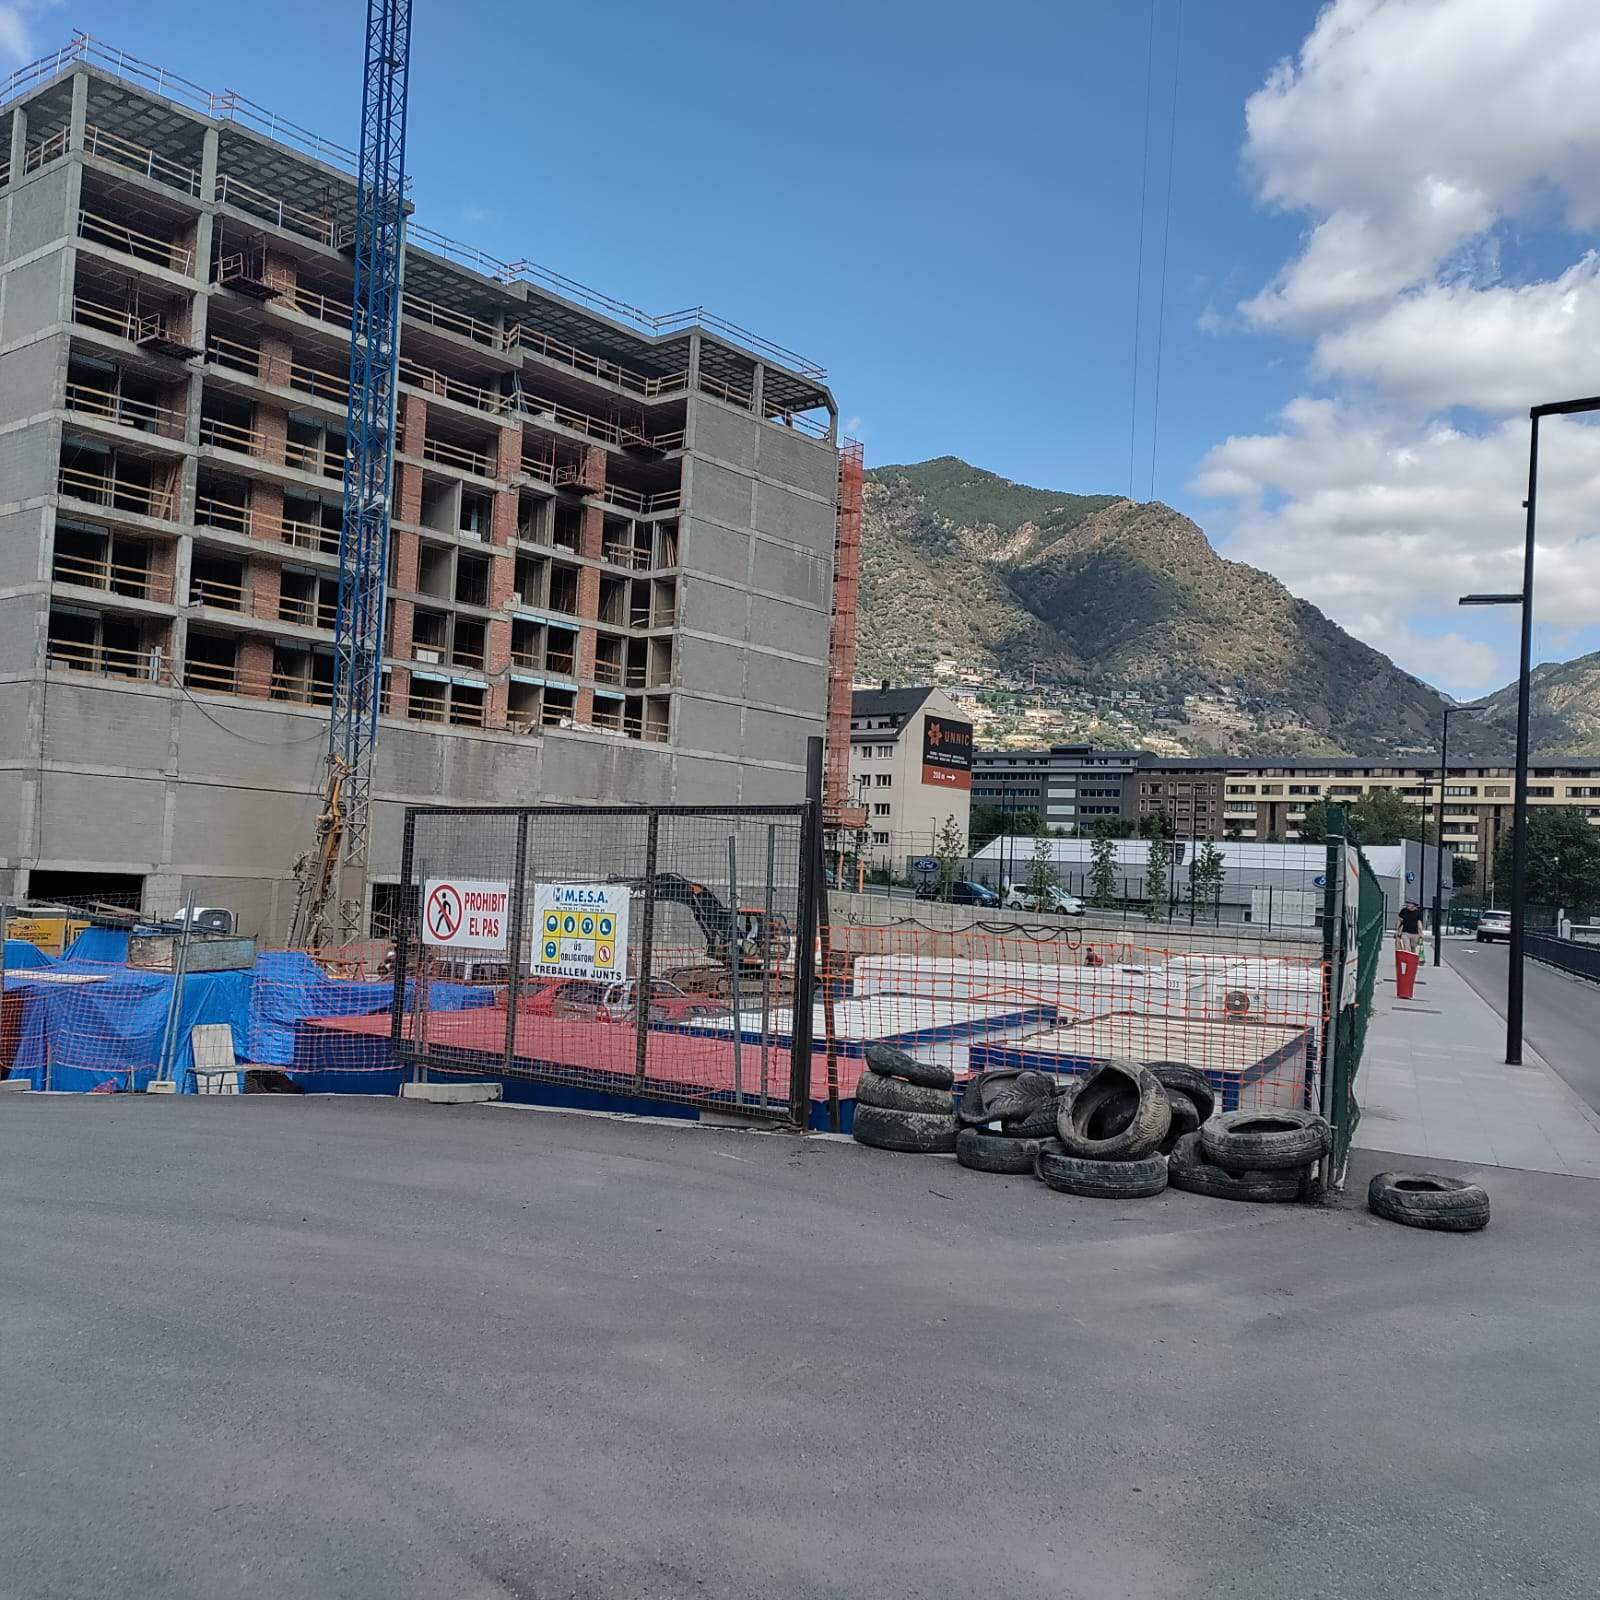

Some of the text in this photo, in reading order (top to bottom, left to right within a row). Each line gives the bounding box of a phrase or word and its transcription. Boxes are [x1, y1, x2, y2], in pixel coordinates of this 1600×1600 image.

[944, 731, 970, 746] UNNIC
[464, 892, 507, 913] PROHIBIT
[564, 889, 608, 903] M.E.S.A.
[469, 917, 499, 938] EL PAS
[560, 953, 594, 963] OBLIGATORI
[534, 965, 622, 981] TREBALLEM JUNTS
